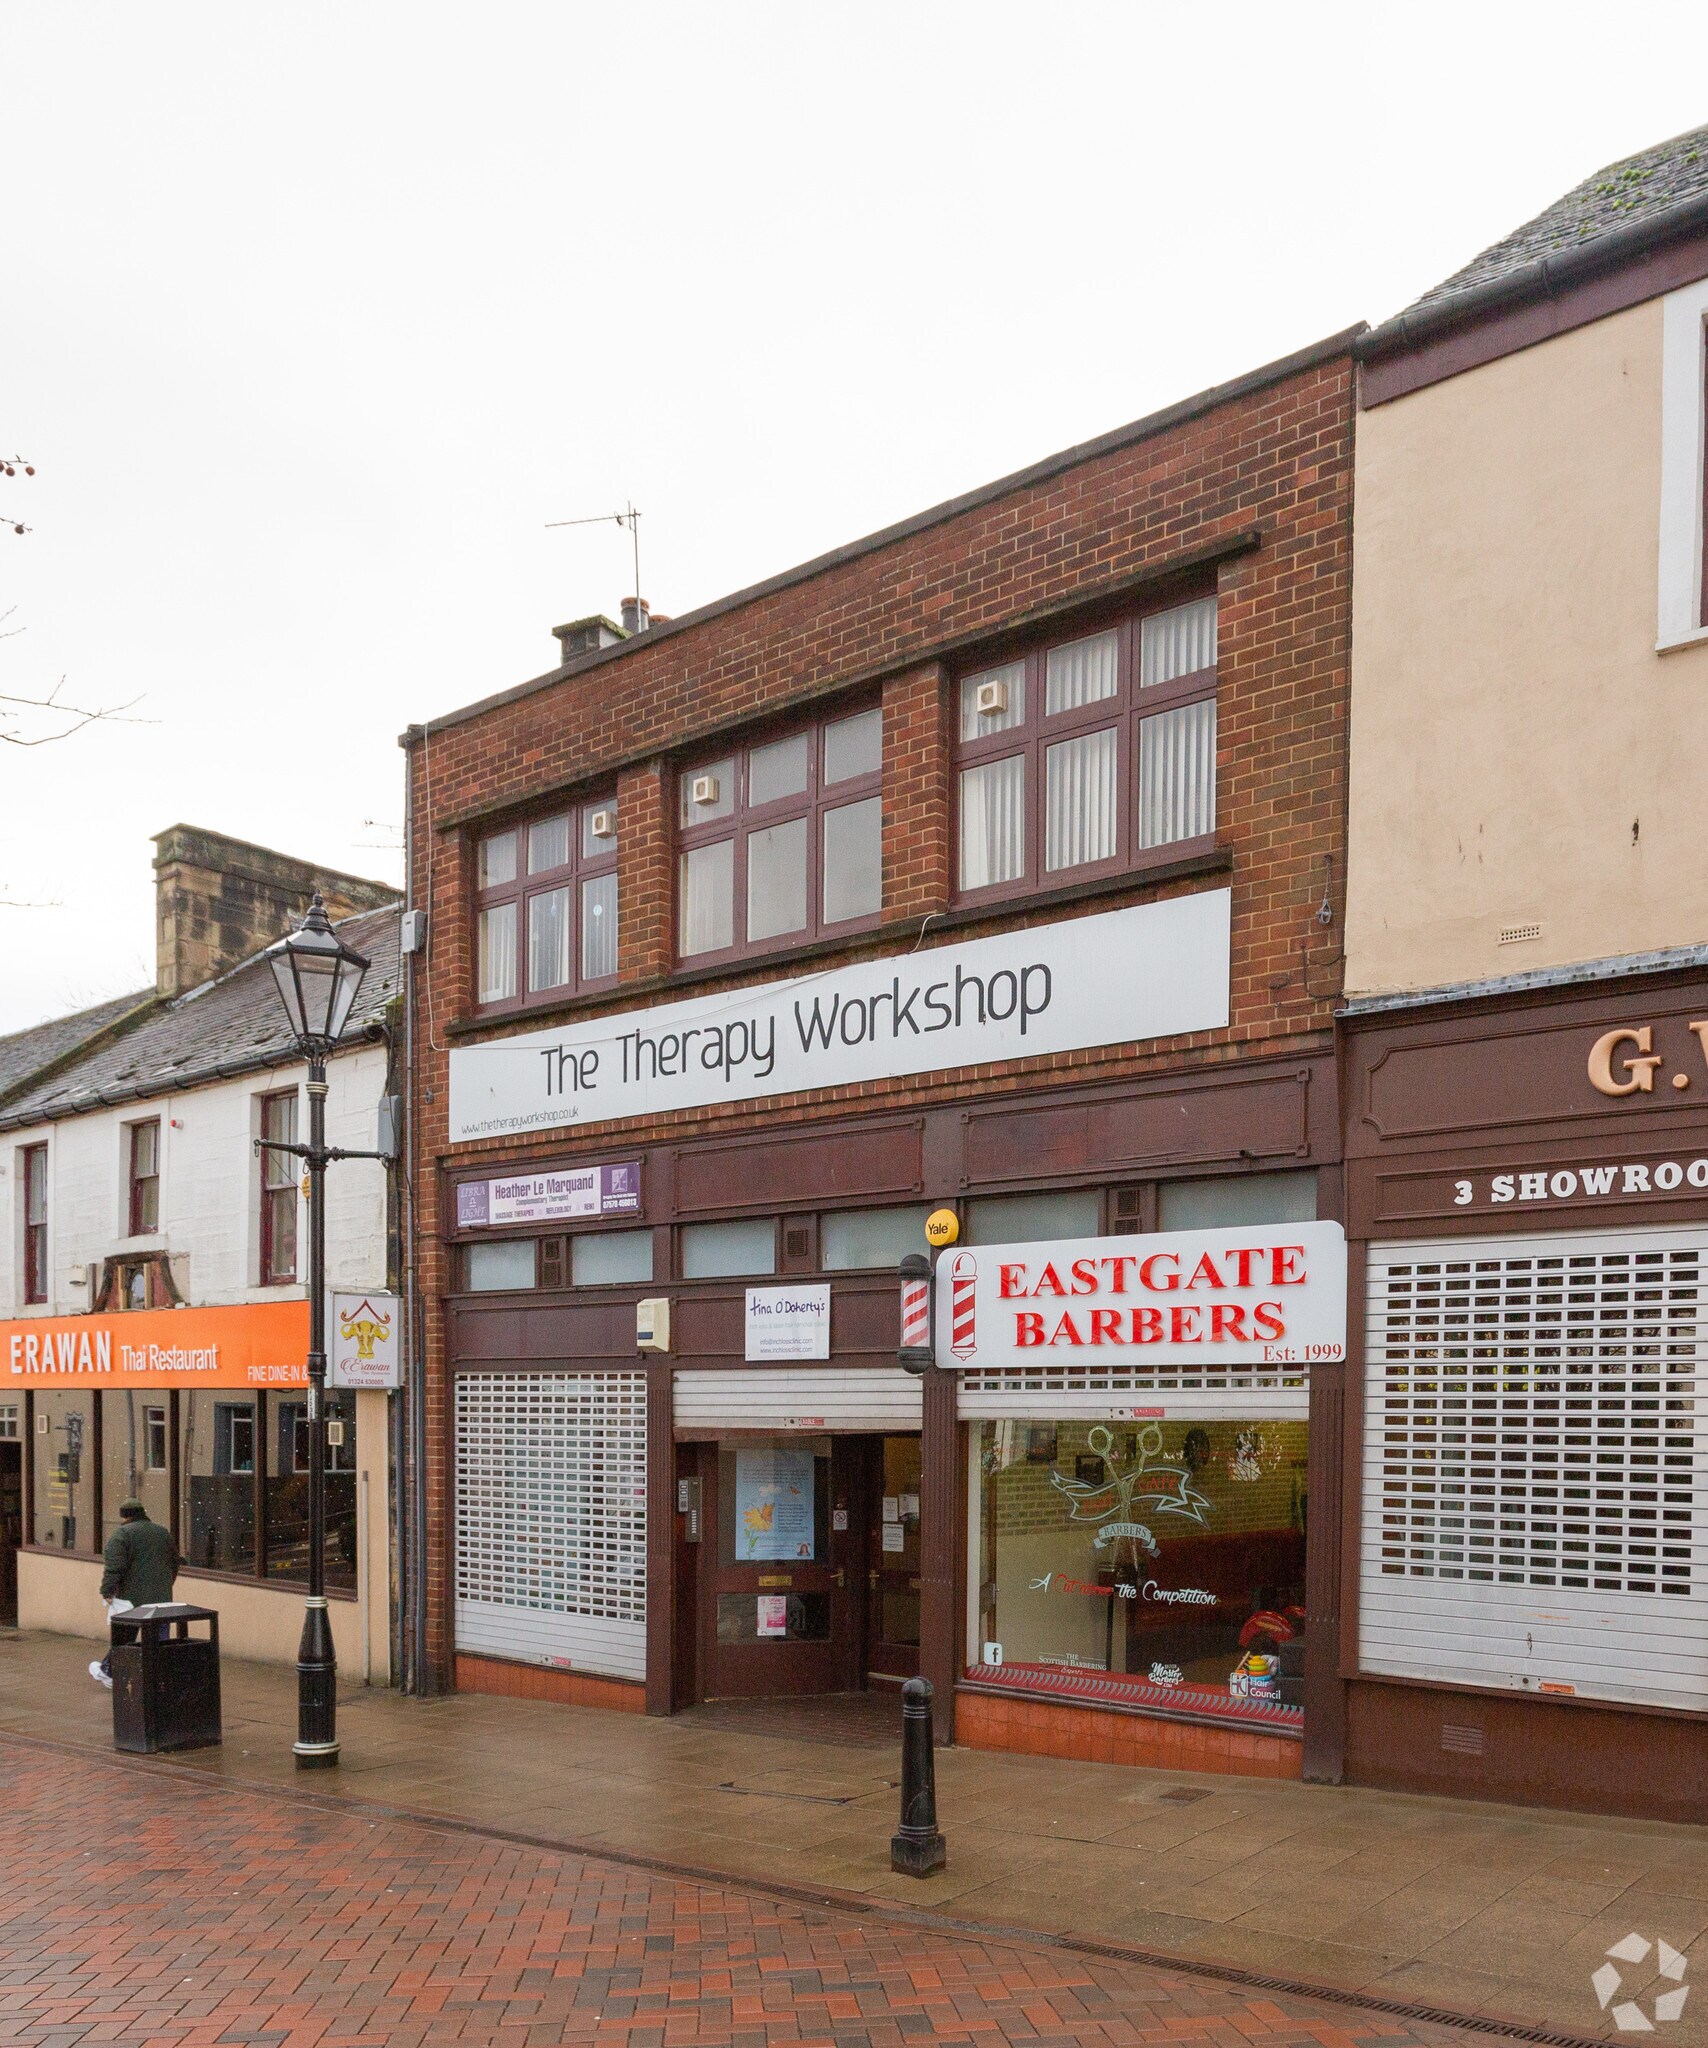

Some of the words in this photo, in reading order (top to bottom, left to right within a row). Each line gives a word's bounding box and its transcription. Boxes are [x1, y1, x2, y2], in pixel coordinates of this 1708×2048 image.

[540, 1043, 599, 1096] The
[616, 1015, 776, 1083] Therapy
[795, 962, 1052, 1054] Workshop
[461, 1106, 579, 1134] www.thetherapyworkshop.co.uk
[495, 1181, 531, 1199] Heather
[533, 1181, 544, 1196] Le
[546, 1174, 594, 1196] Marquand
[1454, 1181, 1473, 1205] 3
[928, 1223, 949, 1235] Yale
[996, 1244, 1307, 1300] EASTGATE
[1012, 1301, 1285, 1348] BARBERS
[10, 1331, 112, 1374] ERAWAN
[121, 1345, 147, 1372] Thai
[149, 1343, 219, 1371] Restaurant
[1263, 1345, 1296, 1362] Est:
[1304, 1342, 1342, 1361] 1999
[247, 1366, 267, 1381] FINE
[268, 1365, 300, 1381] DINE-IN
[302, 1365, 309, 1381] &
[340, 1357, 390, 1375] Erawan
[1104, 1525, 1147, 1538] BARBERS
[1029, 1573, 1052, 1593] A
[1115, 1584, 1137, 1598] the
[1142, 1580, 1217, 1605] Competition
[1250, 1677, 1269, 1688] Hair
[1250, 1687, 1281, 1700] Council
